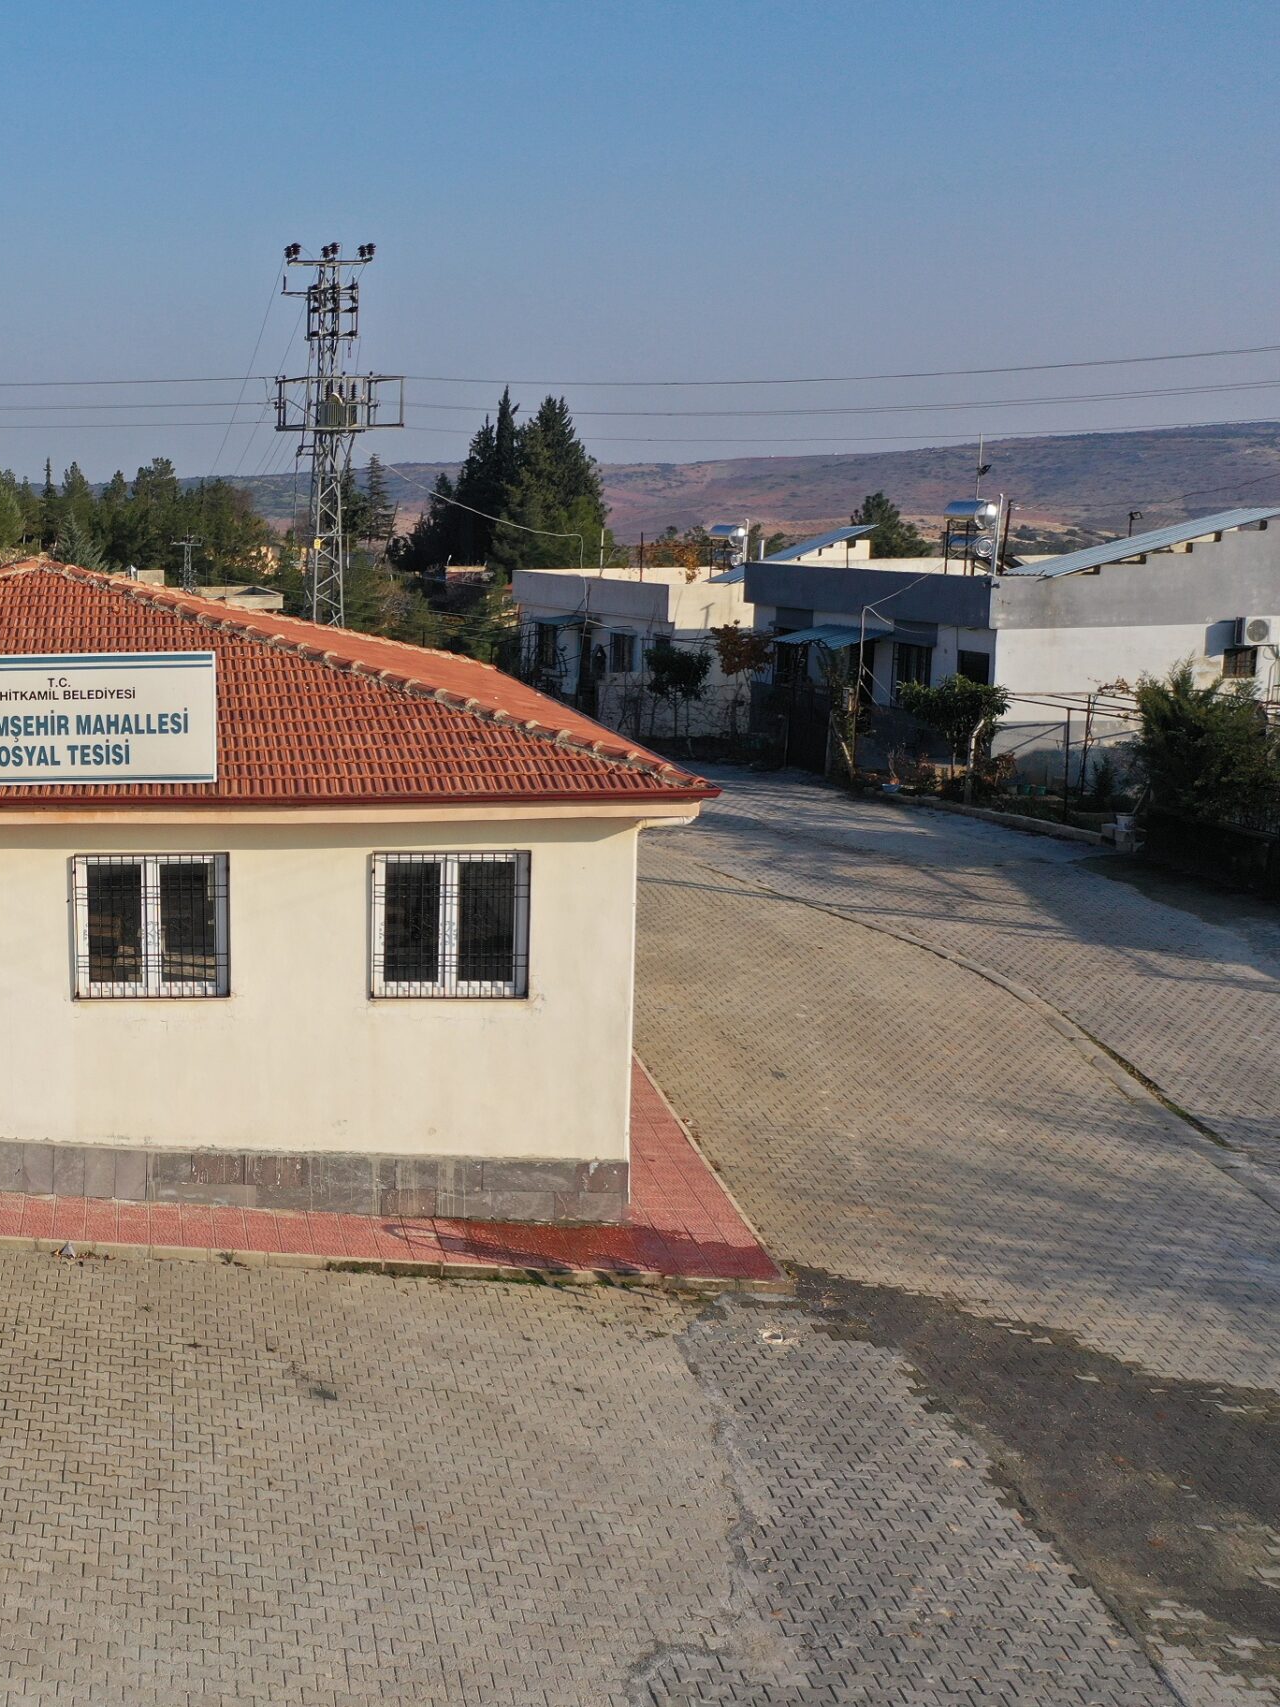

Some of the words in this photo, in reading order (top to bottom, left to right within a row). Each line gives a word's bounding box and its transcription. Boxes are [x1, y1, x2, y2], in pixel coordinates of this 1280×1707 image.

[47, 677, 71, 688] T.C.
[63, 686, 136, 700] BELEDİYESİ
[75, 707, 189, 735] MAHALLESİ
[66, 738, 131, 766] TESİSİ
